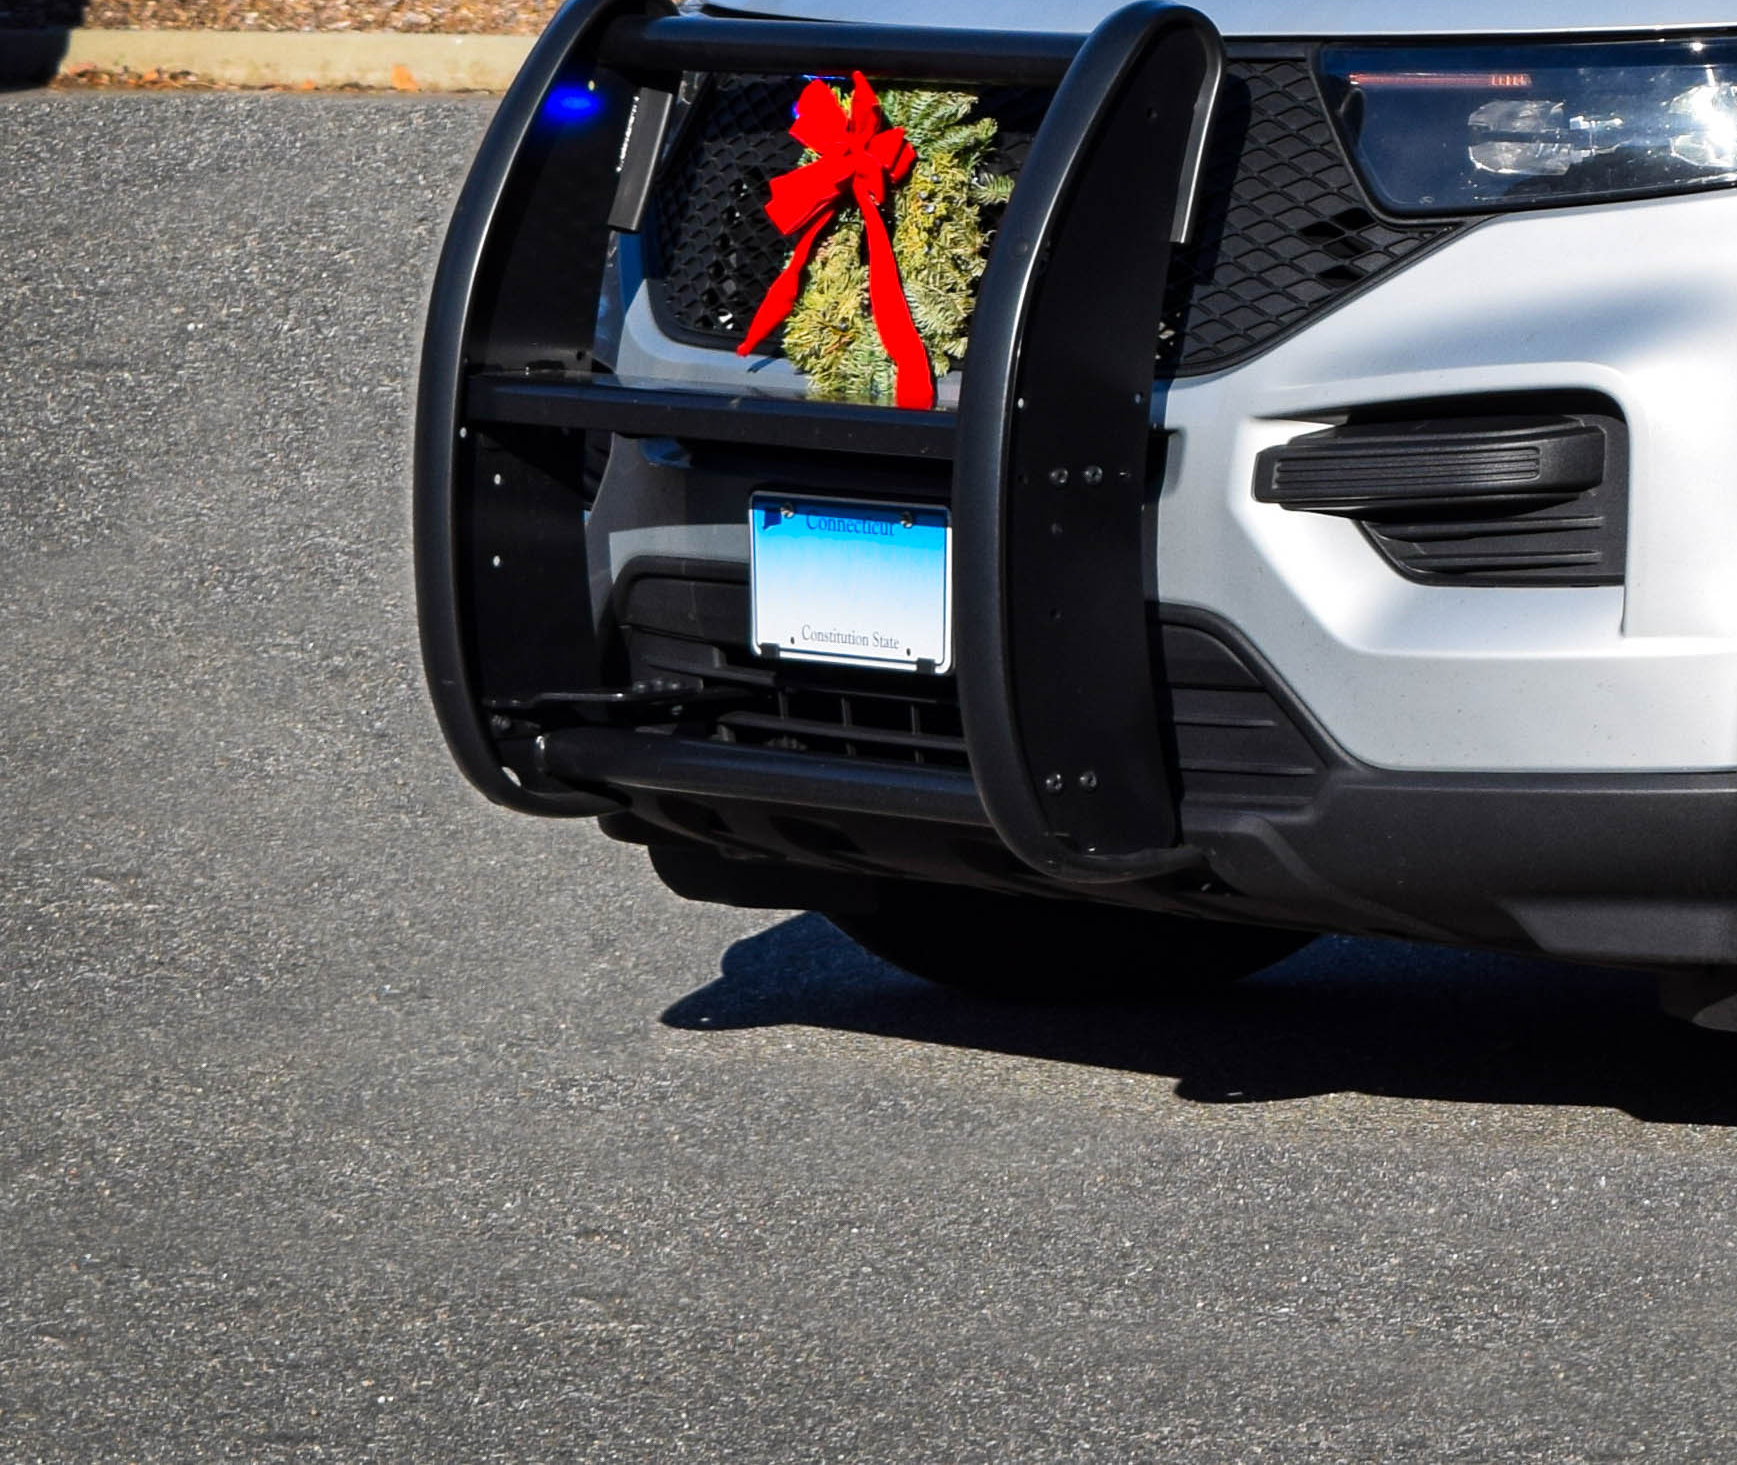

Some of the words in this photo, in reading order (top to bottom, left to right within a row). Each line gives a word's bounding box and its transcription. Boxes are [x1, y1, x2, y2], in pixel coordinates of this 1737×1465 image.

[806, 510, 895, 535] Connecticut
[801, 624, 869, 646] Constitution
[872, 631, 900, 649] State
